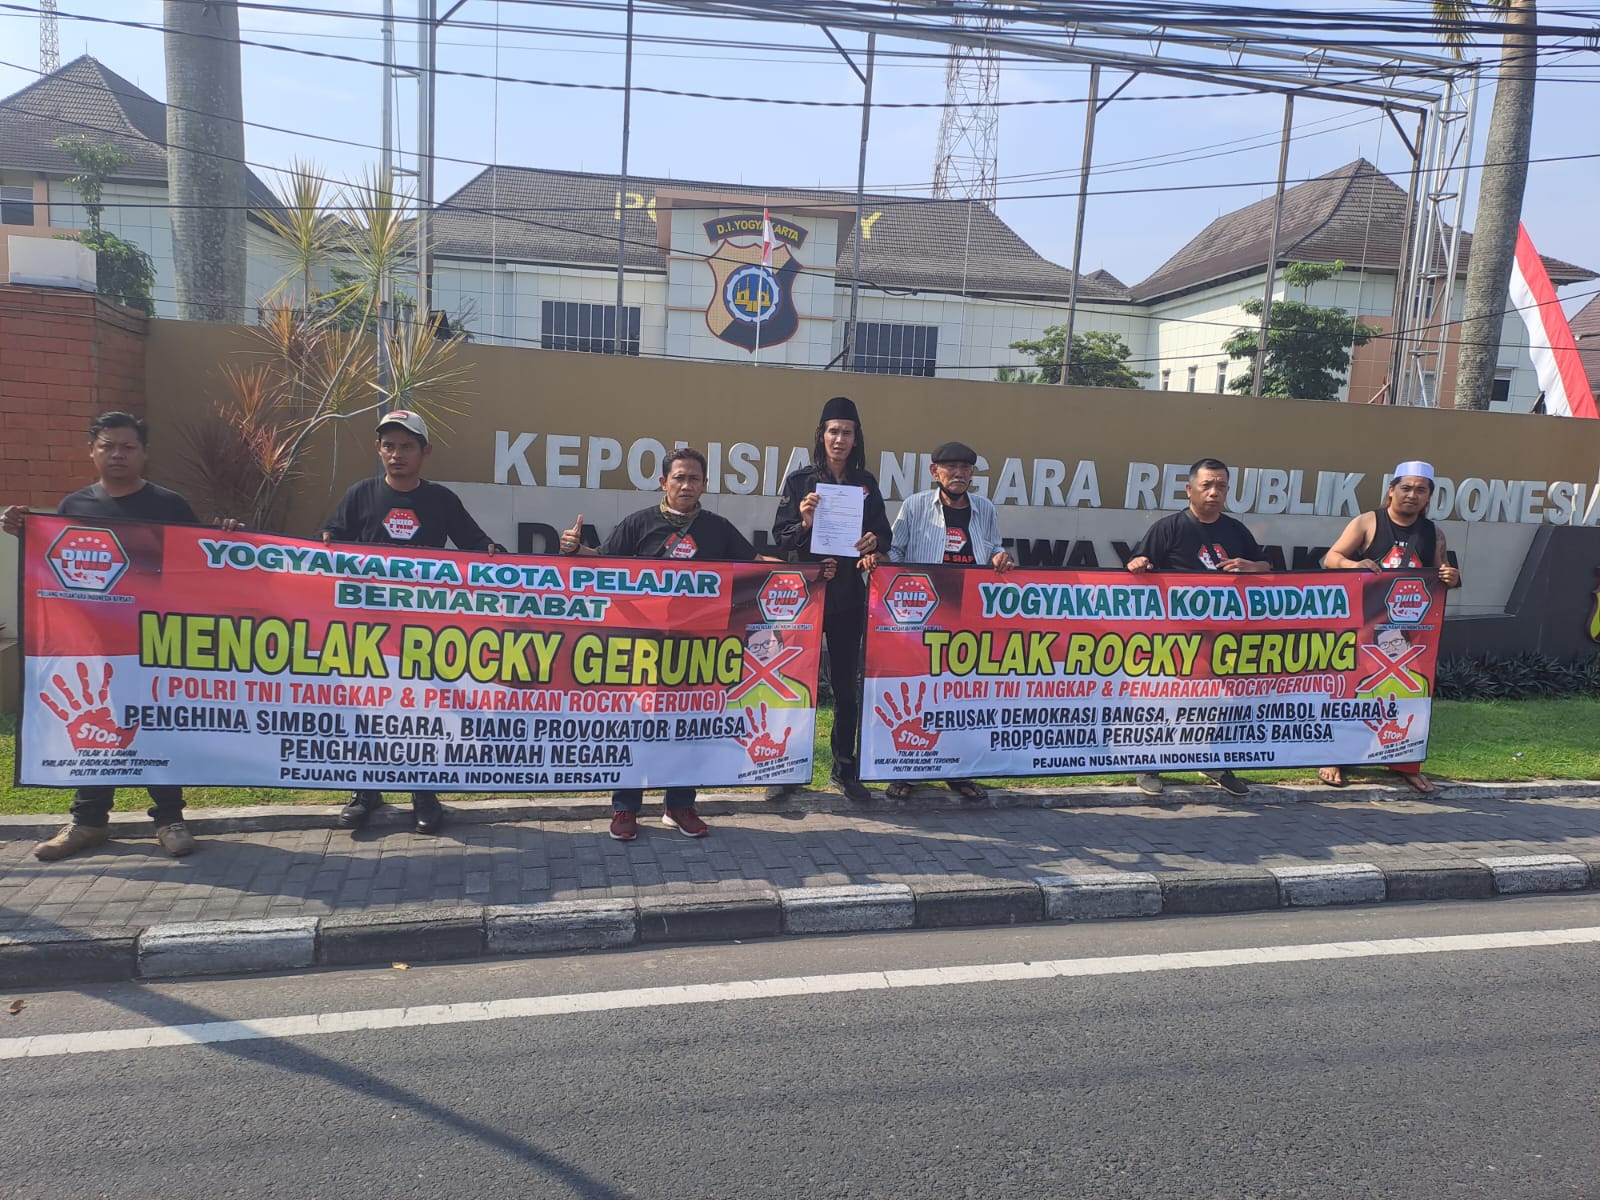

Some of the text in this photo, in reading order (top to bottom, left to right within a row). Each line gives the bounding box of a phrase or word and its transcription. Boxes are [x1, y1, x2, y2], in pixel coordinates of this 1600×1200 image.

[494, 430, 812, 497] KEPOISIA
[1124, 462, 1367, 517] REUBLIK
[1380, 473, 1600, 527] IDONESI
[61, 548, 112, 572] PNIB
[200, 541, 719, 595] YOGYAKARTA KOTA PELAJAR
[337, 583, 609, 620] BERMARTABAT
[980, 585, 1349, 618] YOGYAKARTA KOTA BUDAYA
[139, 612, 744, 686] MENOLAK ROCKY GERUNG
[923, 631, 1357, 677] TOLAK ROCKY GERUNG
[168, 676, 236, 701] POLRI
[245, 681, 281, 703] TNI
[289, 683, 392, 707] TANGKAP
[400, 687, 416, 708] &
[424, 688, 562, 712] PENJARAKAN
[569, 691, 635, 713] ROCKY
[943, 680, 989, 700] POLRI
[994, 681, 1021, 699] TNI
[1026, 680, 1097, 699] TANGKAP
[1101, 680, 1113, 697] &
[1118, 680, 1223, 699] PENJARAKAN
[1224, 679, 1275, 697] ROCKY
[124, 705, 747, 741] PENGHINA SIMBOL NEGARA, BIANG PROVOKATOR BANGSA
[922, 701, 1398, 730] PERUSAK DEMOKRASI BANGSA, PENGHINA SIMBOL NEGARA &
[77, 723, 122, 746] STOP!
[899, 729, 930, 748] STOP!
[989, 723, 1334, 749] PROPOGANDA PERUSAK MORALITAS BANGSA
[280, 738, 633, 768] PENGHANCUR MARWAH NEGARA
[754, 745, 780, 757] STOP!
[1032, 751, 1275, 769] PEJUANG NUSANTARA INDONESIA BERSATU
[280, 767, 621, 784] PEJUANG NUSANTARA INDONESIA BERSATU
